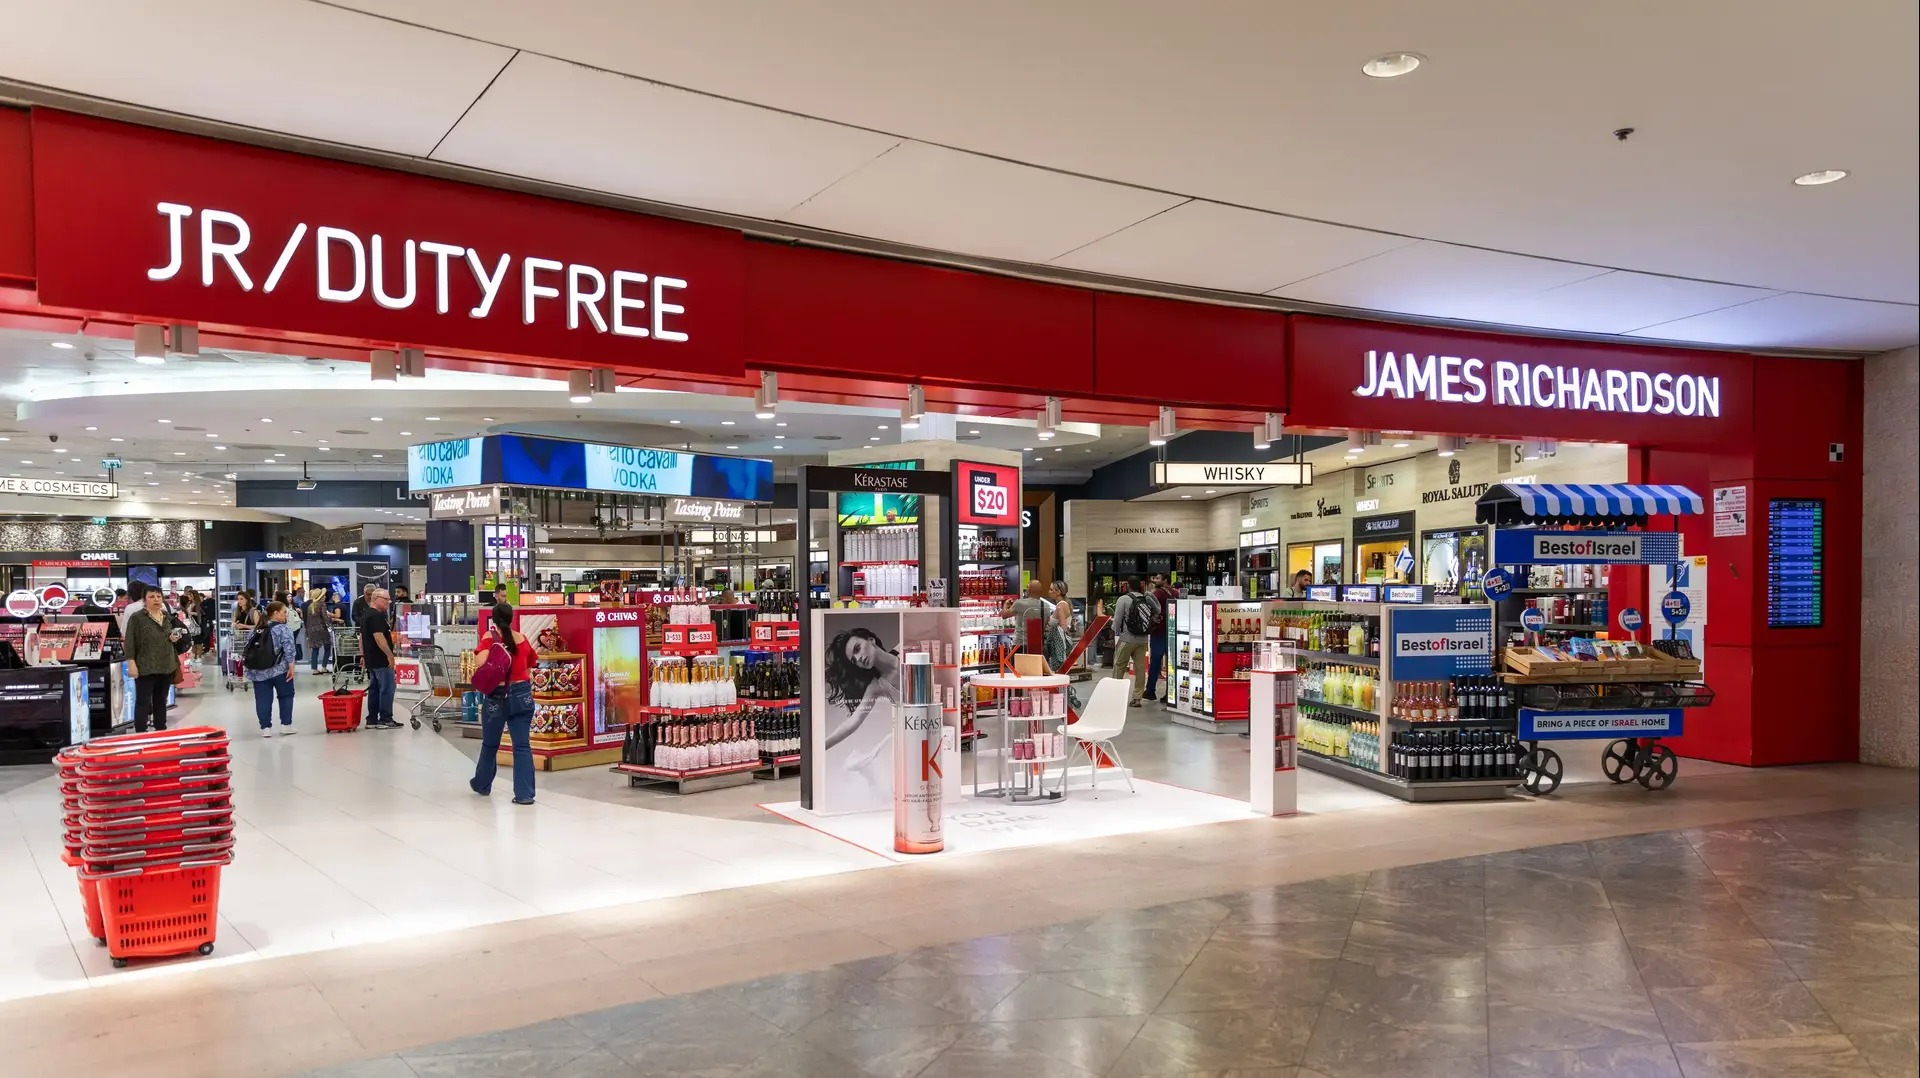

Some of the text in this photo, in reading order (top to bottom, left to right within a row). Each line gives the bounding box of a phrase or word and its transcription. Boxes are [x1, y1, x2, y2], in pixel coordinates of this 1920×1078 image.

[523, 257, 689, 342] FREE
[1354, 349, 1720, 417] JAMES RICHARDSON
[422, 466, 454, 485] VODKA
[611, 467, 657, 490] VODKA
[854, 473, 908, 488] KÉRASTASE
[974, 476, 991, 484] UNDER
[1204, 467, 1265, 481] WHISKY
[20, 481, 29, 490] &
[34, 481, 109, 495] COSMETICS
[1422, 482, 1489, 504] ROYAL SALUTE
[433, 491, 492, 515] Tasting Point
[977, 488, 1005, 511] $20
[1250, 498, 1269, 509] SPIRITS
[1355, 499, 1379, 512] WHISKY
[674, 499, 743, 521] Tasting Point
[713, 532, 750, 541] COGNAC
[1114, 526, 1180, 535] JOHNNIE WALKER
[1539, 539, 1636, 556] BestofIsrael
[80, 552, 120, 561] CHANEL
[607, 611, 638, 621] CHIVAS
[1401, 637, 1484, 652] BestofIsrael
[1537, 718, 1666, 728] BRING A PIECE OF ISRAEL HOME
